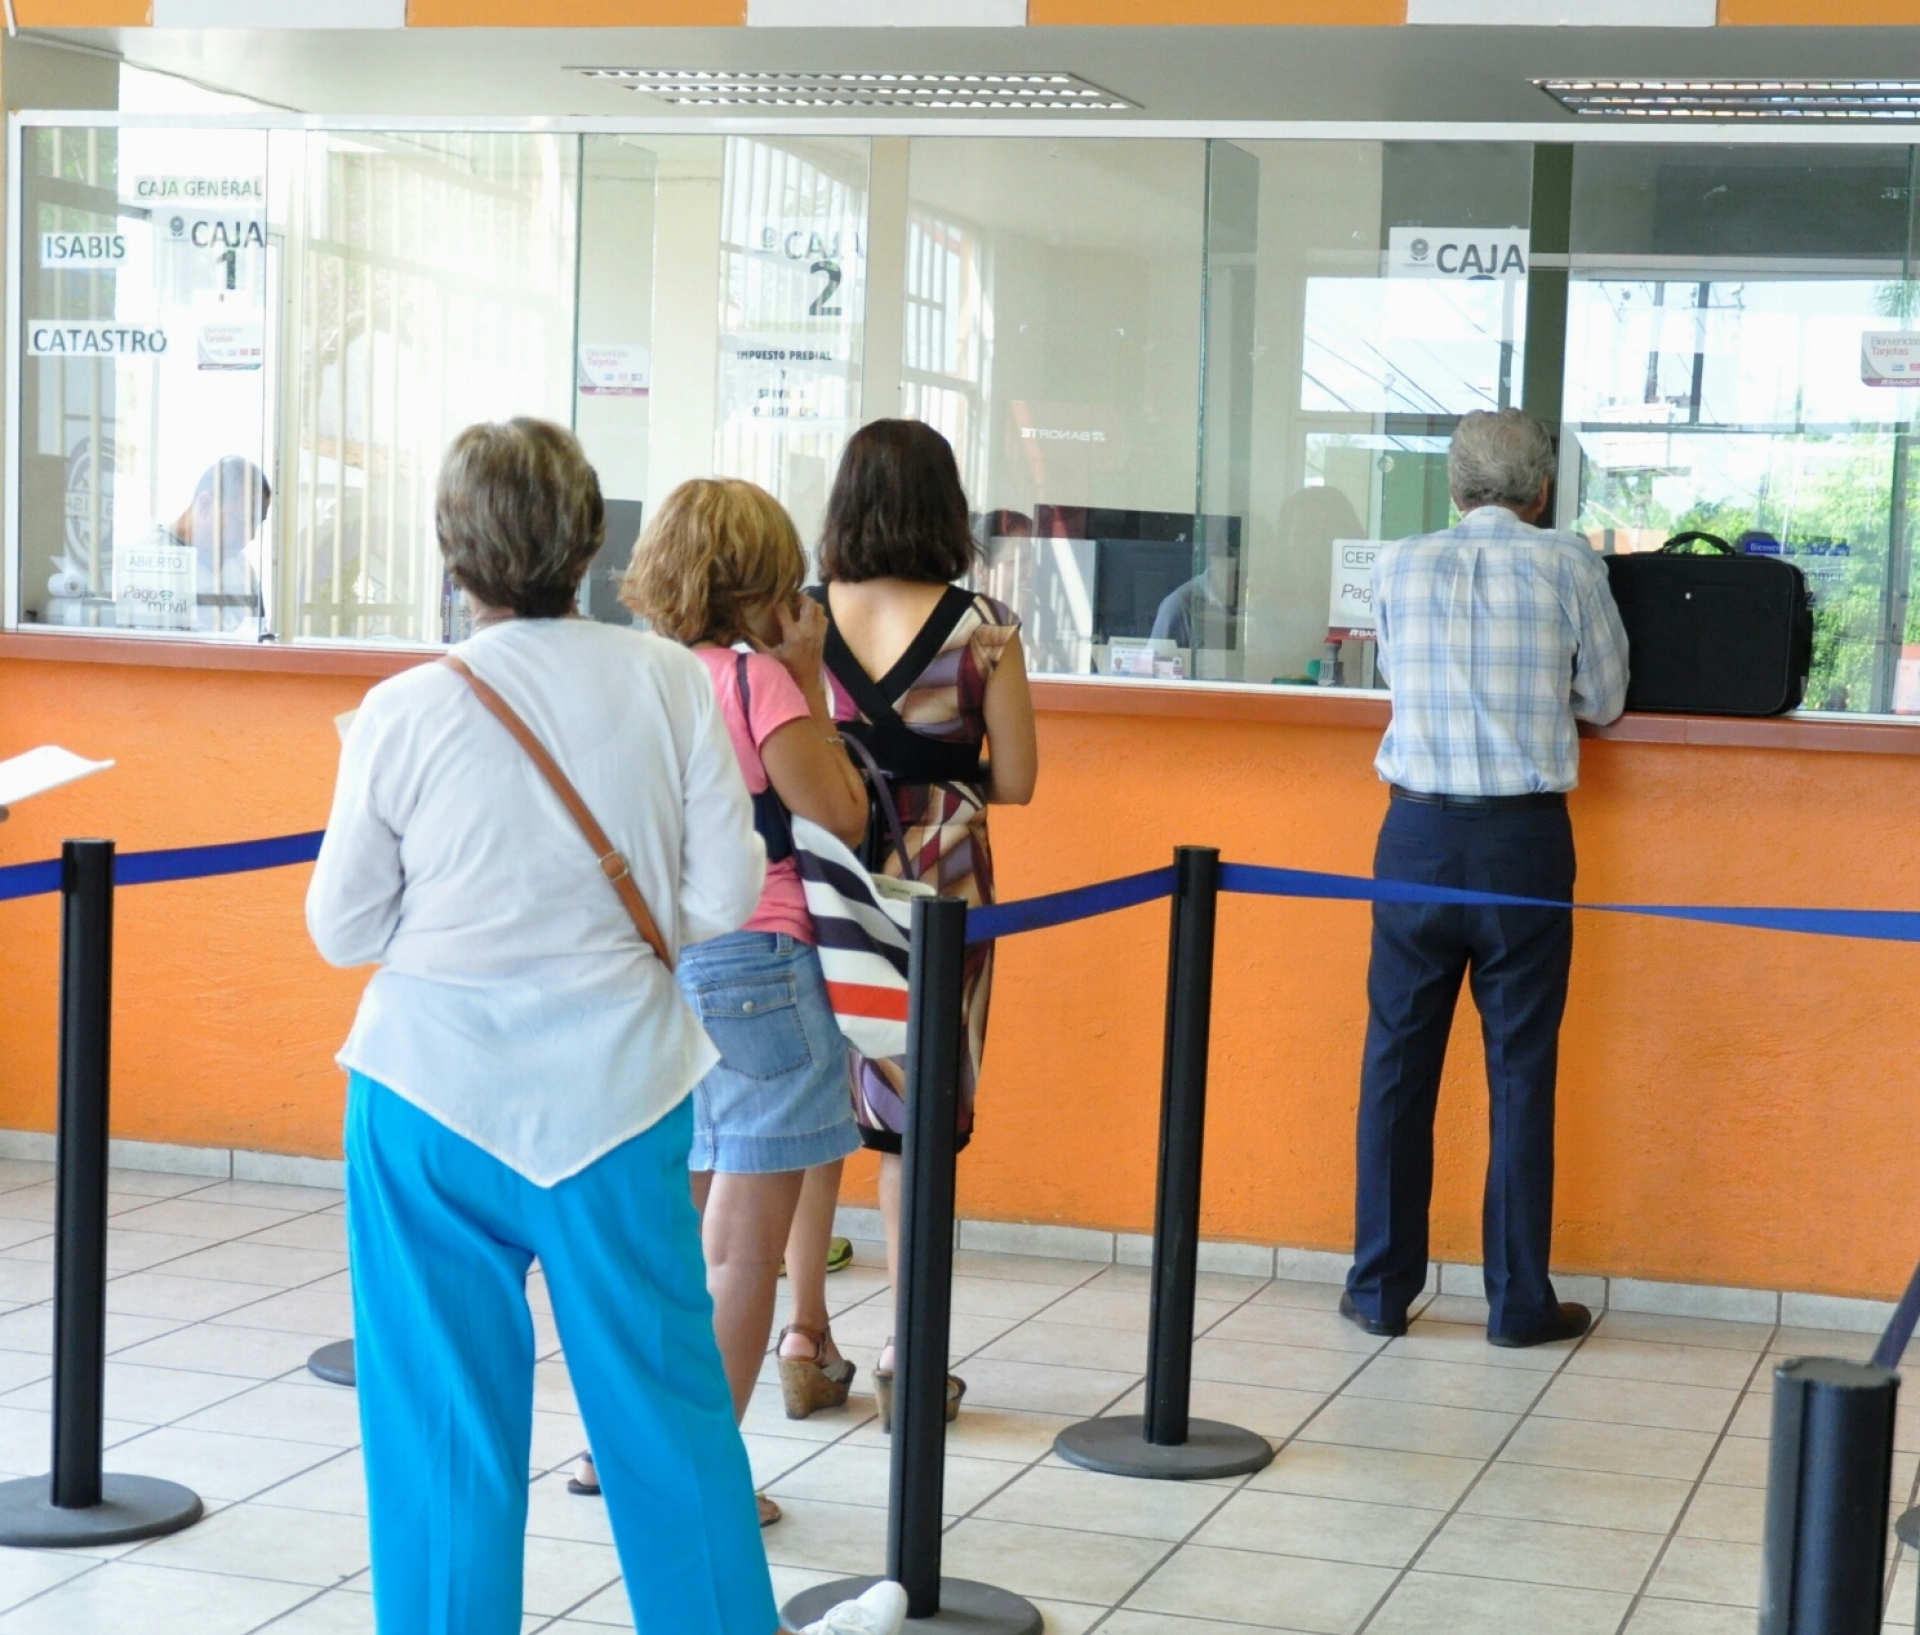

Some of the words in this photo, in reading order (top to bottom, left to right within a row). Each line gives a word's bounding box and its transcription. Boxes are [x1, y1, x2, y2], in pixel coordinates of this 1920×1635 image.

[137, 181, 179, 197] CAJA
[184, 181, 263, 197] GENERAL
[191, 220, 264, 248] CAJA
[46, 235, 126, 259] ISABIS
[1436, 243, 1526, 274] CAJA
[216, 249, 236, 290] 1
[808, 260, 842, 316] 2
[33, 328, 168, 353] CATASTRO
[1872, 346, 1909, 357] Tarjetas
[737, 350, 786, 361] IMPUESTO
[789, 350, 832, 361] PREDIAL
[128, 555, 182, 569] ABIERTO
[123, 585, 158, 603] Pago
